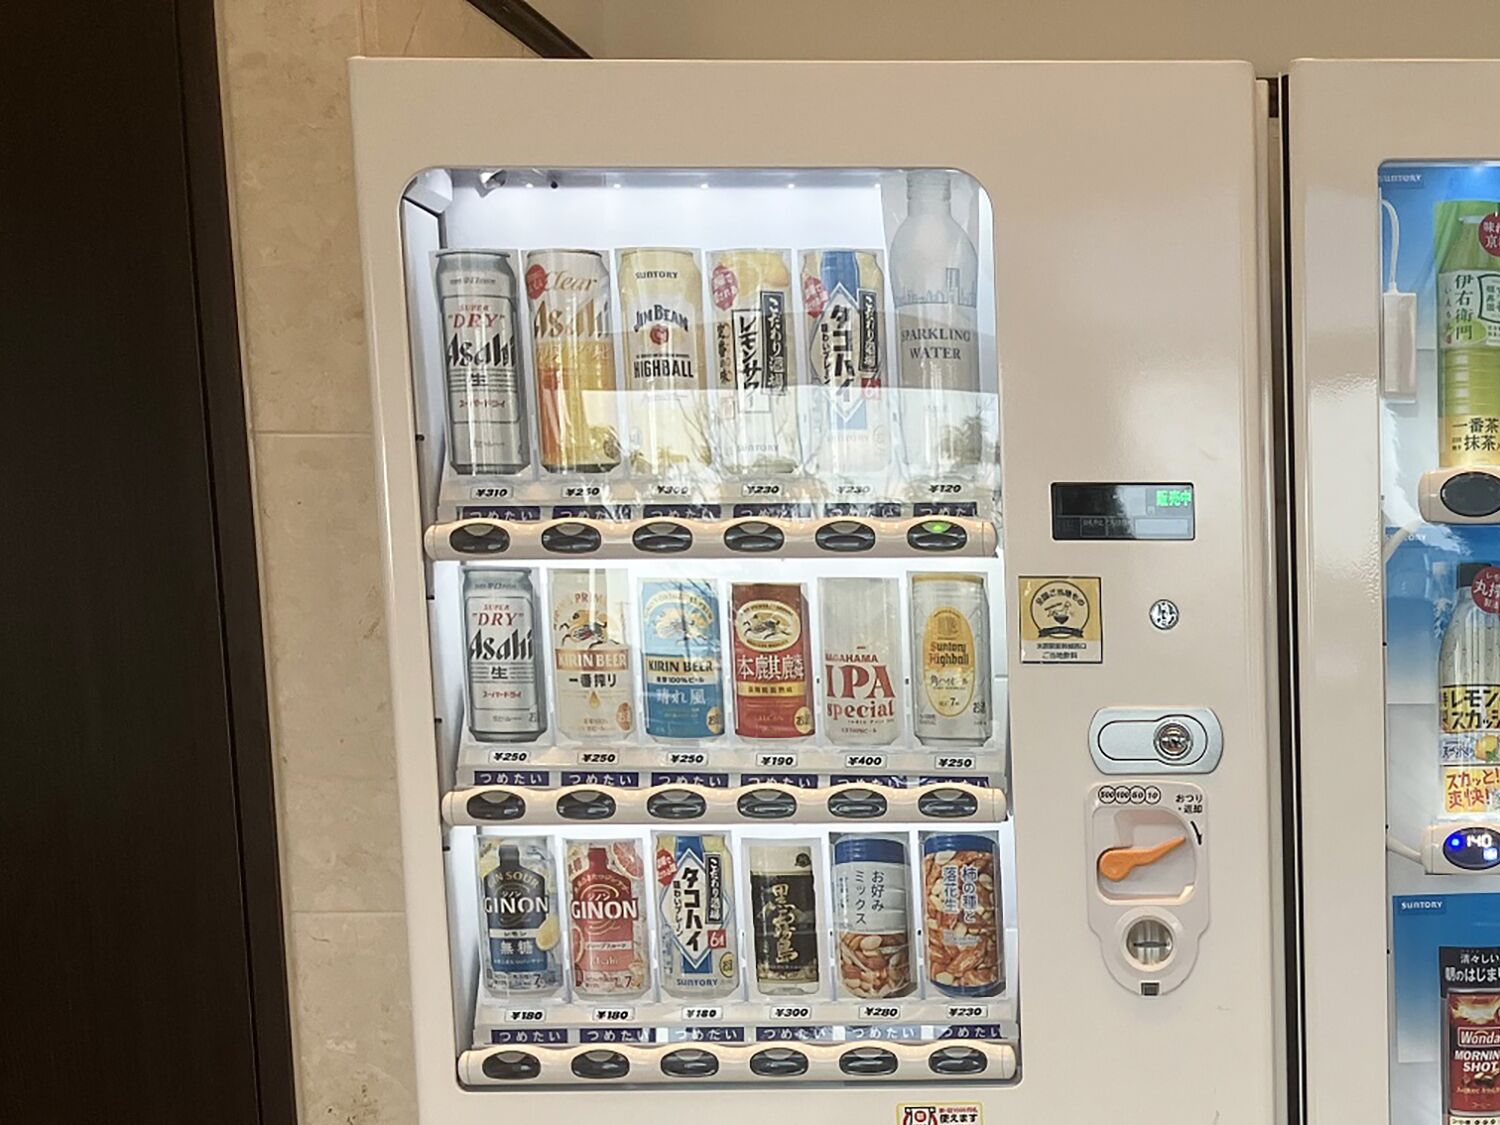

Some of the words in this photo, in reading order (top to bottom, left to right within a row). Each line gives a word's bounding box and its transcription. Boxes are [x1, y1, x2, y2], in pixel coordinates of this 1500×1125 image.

[1454, 273, 1474, 341] 伊右衛門
[901, 327, 971, 343] SPARKLING
[909, 347, 962, 361] WATER
[634, 359, 694, 379] HIGHBALL
[476, 488, 508, 498] ¥310
[929, 484, 961, 493] ¥120
[470, 629, 532, 660] Asahi
[558, 652, 590, 668] KIRIN
[595, 652, 626, 667] BEER
[648, 659, 681, 673] KIRIN
[684, 658, 713, 672] BEER
[736, 654, 805, 681] 本麒麟
[490, 667, 509, 680] 生
[568, 673, 617, 688] 一番搾り
[825, 664, 896, 698] IPA
[1450, 688, 1499, 707] レモン
[826, 700, 895, 719] special
[493, 752, 527, 762] ¥250
[581, 753, 616, 763] ¥250
[670, 754, 705, 764] ¥250
[761, 756, 794, 766] ¥190
[848, 756, 882, 766] ¥400
[938, 758, 972, 768] ¥250
[480, 773, 543, 784] つめたい
[1446, 768, 1500, 787] スカッと!
[1175, 794, 1203, 804] おつり
[1448, 790, 1490, 808] 爽快!
[855, 869, 867, 925] ミックス
[870, 871, 885, 912] お好み
[943, 866, 957, 914] 落花生
[961, 865, 977, 924] 柿の種と
[484, 896, 550, 915] GINON
[572, 900, 639, 919] GINON
[682, 866, 702, 952] タコハイ
[771, 884, 798, 963] 黒霧島
[1460, 953, 1500, 964] 清々しい
[511, 1010, 543, 1020] ¥180
[596, 1010, 629, 1020] ¥180
[775, 1008, 809, 1017] ¥300
[864, 1007, 898, 1016] ¥280
[949, 1007, 982, 1016] ¥230
[1462, 1060, 1498, 1073] SHOT
